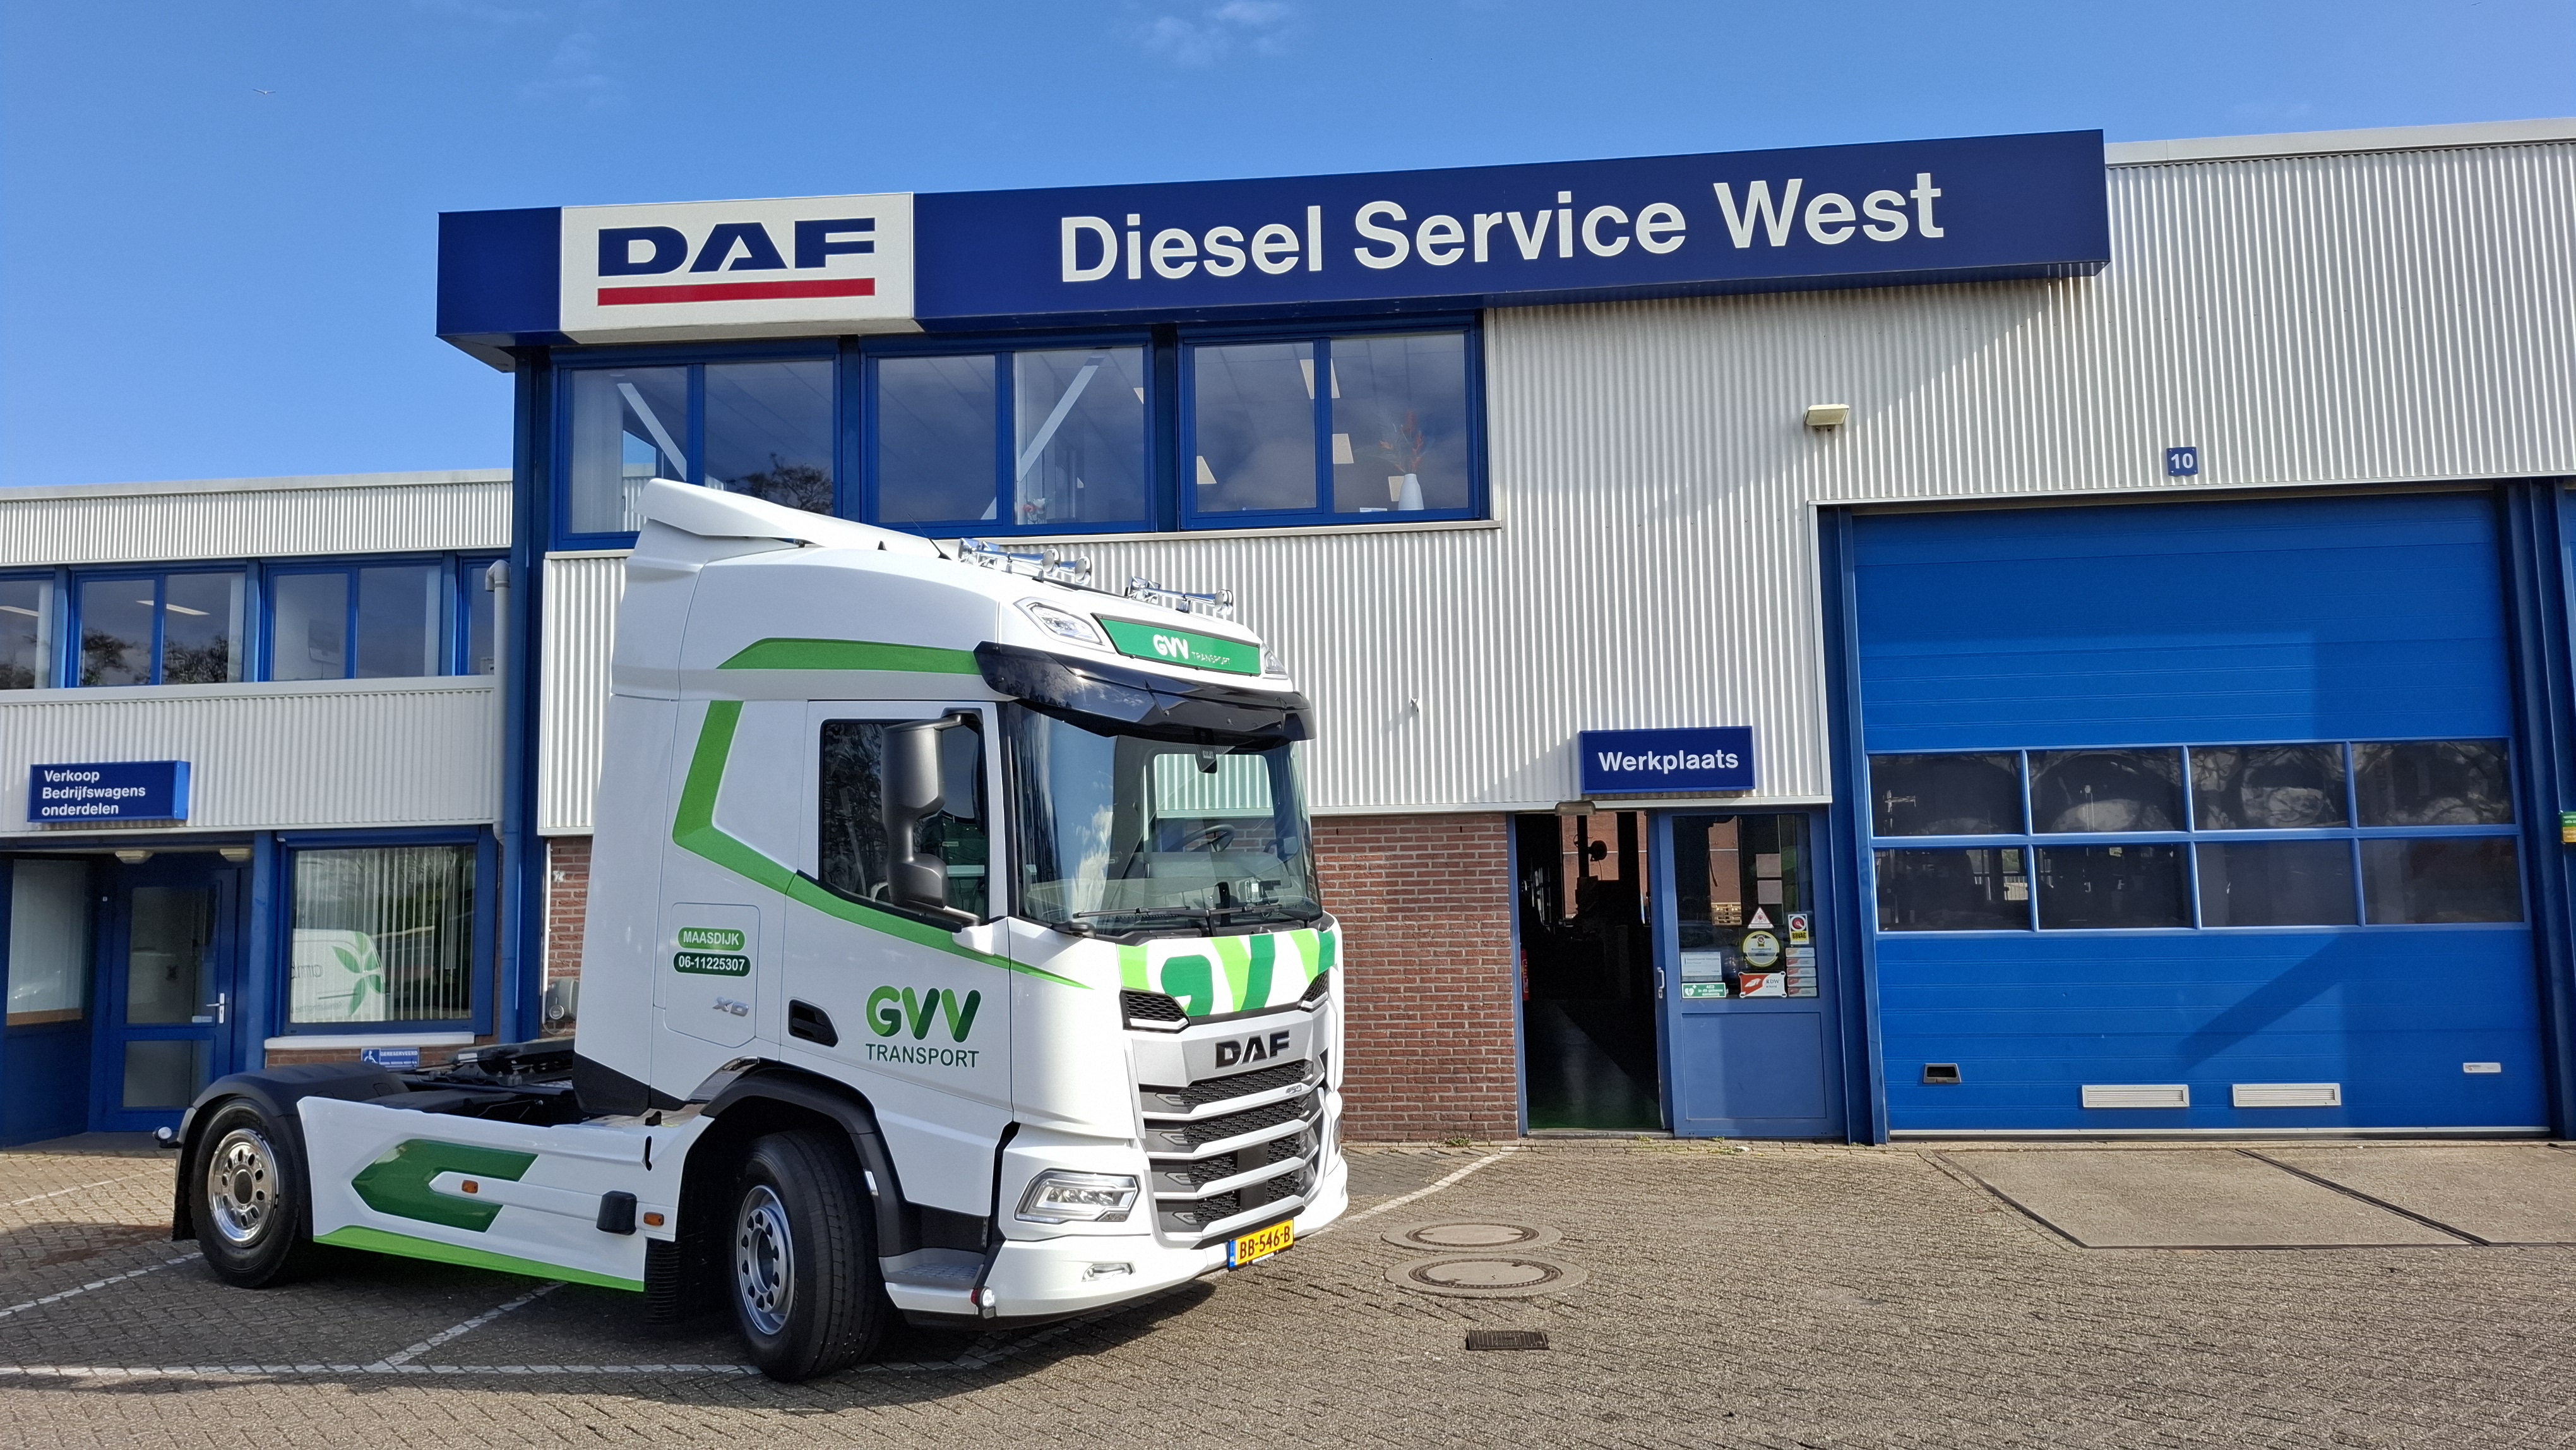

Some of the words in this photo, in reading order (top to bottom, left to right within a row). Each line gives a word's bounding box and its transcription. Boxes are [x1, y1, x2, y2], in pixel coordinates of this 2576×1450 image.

[1061, 205, 1323, 284] Diesel
[1354, 190, 1688, 270] Service
[1713, 172, 1945, 249] West
[598, 217, 876, 277] DAF
[2171, 453, 2193, 469] 10
[1153, 634, 1189, 659] GVV
[1598, 749, 1739, 774] Werkplaats
[44, 769, 100, 784] Verkoop
[42, 786, 146, 801] Bedrijfswagens
[42, 803, 119, 816] onderdelen
[683, 931, 739, 945] MAASDIJK
[679, 956, 745, 971] 06-11225307
[712, 997, 749, 1017] XD
[866, 985, 982, 1043] GVV
[866, 1043, 980, 1068] TRANSPORT
[1215, 1029, 1291, 1069] DAF
[1239, 1225, 1291, 1260] BB-546-B
